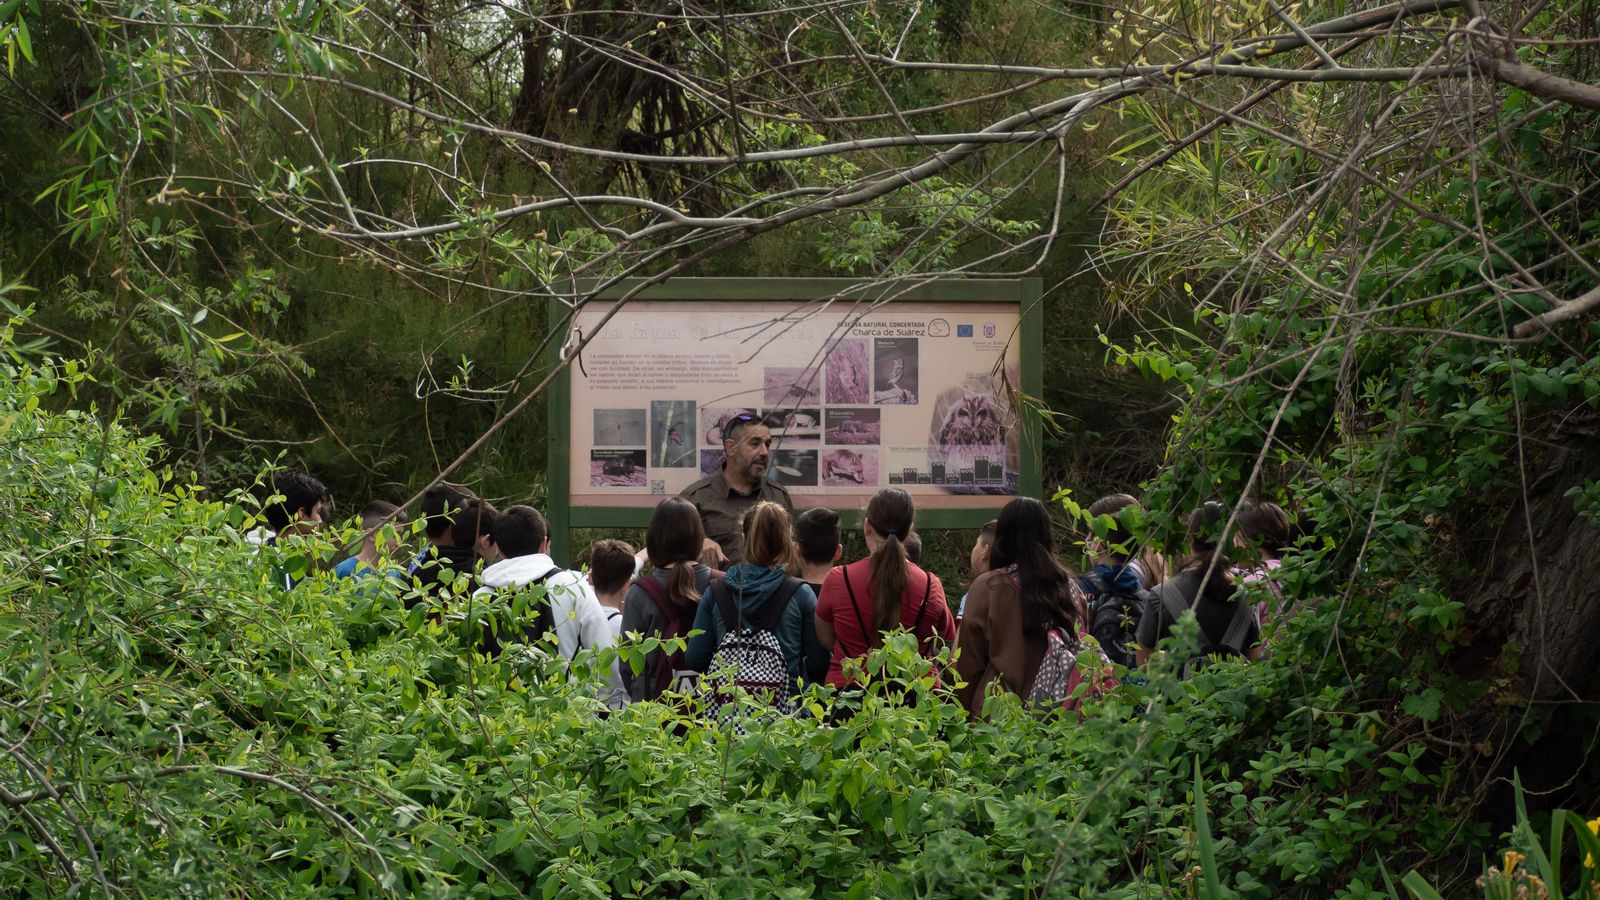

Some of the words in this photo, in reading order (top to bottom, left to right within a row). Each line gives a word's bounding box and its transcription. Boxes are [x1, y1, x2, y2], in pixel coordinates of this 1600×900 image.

[852, 327, 881, 336] Charca
[883, 327, 894, 336] de
[896, 327, 925, 336] Suárez
